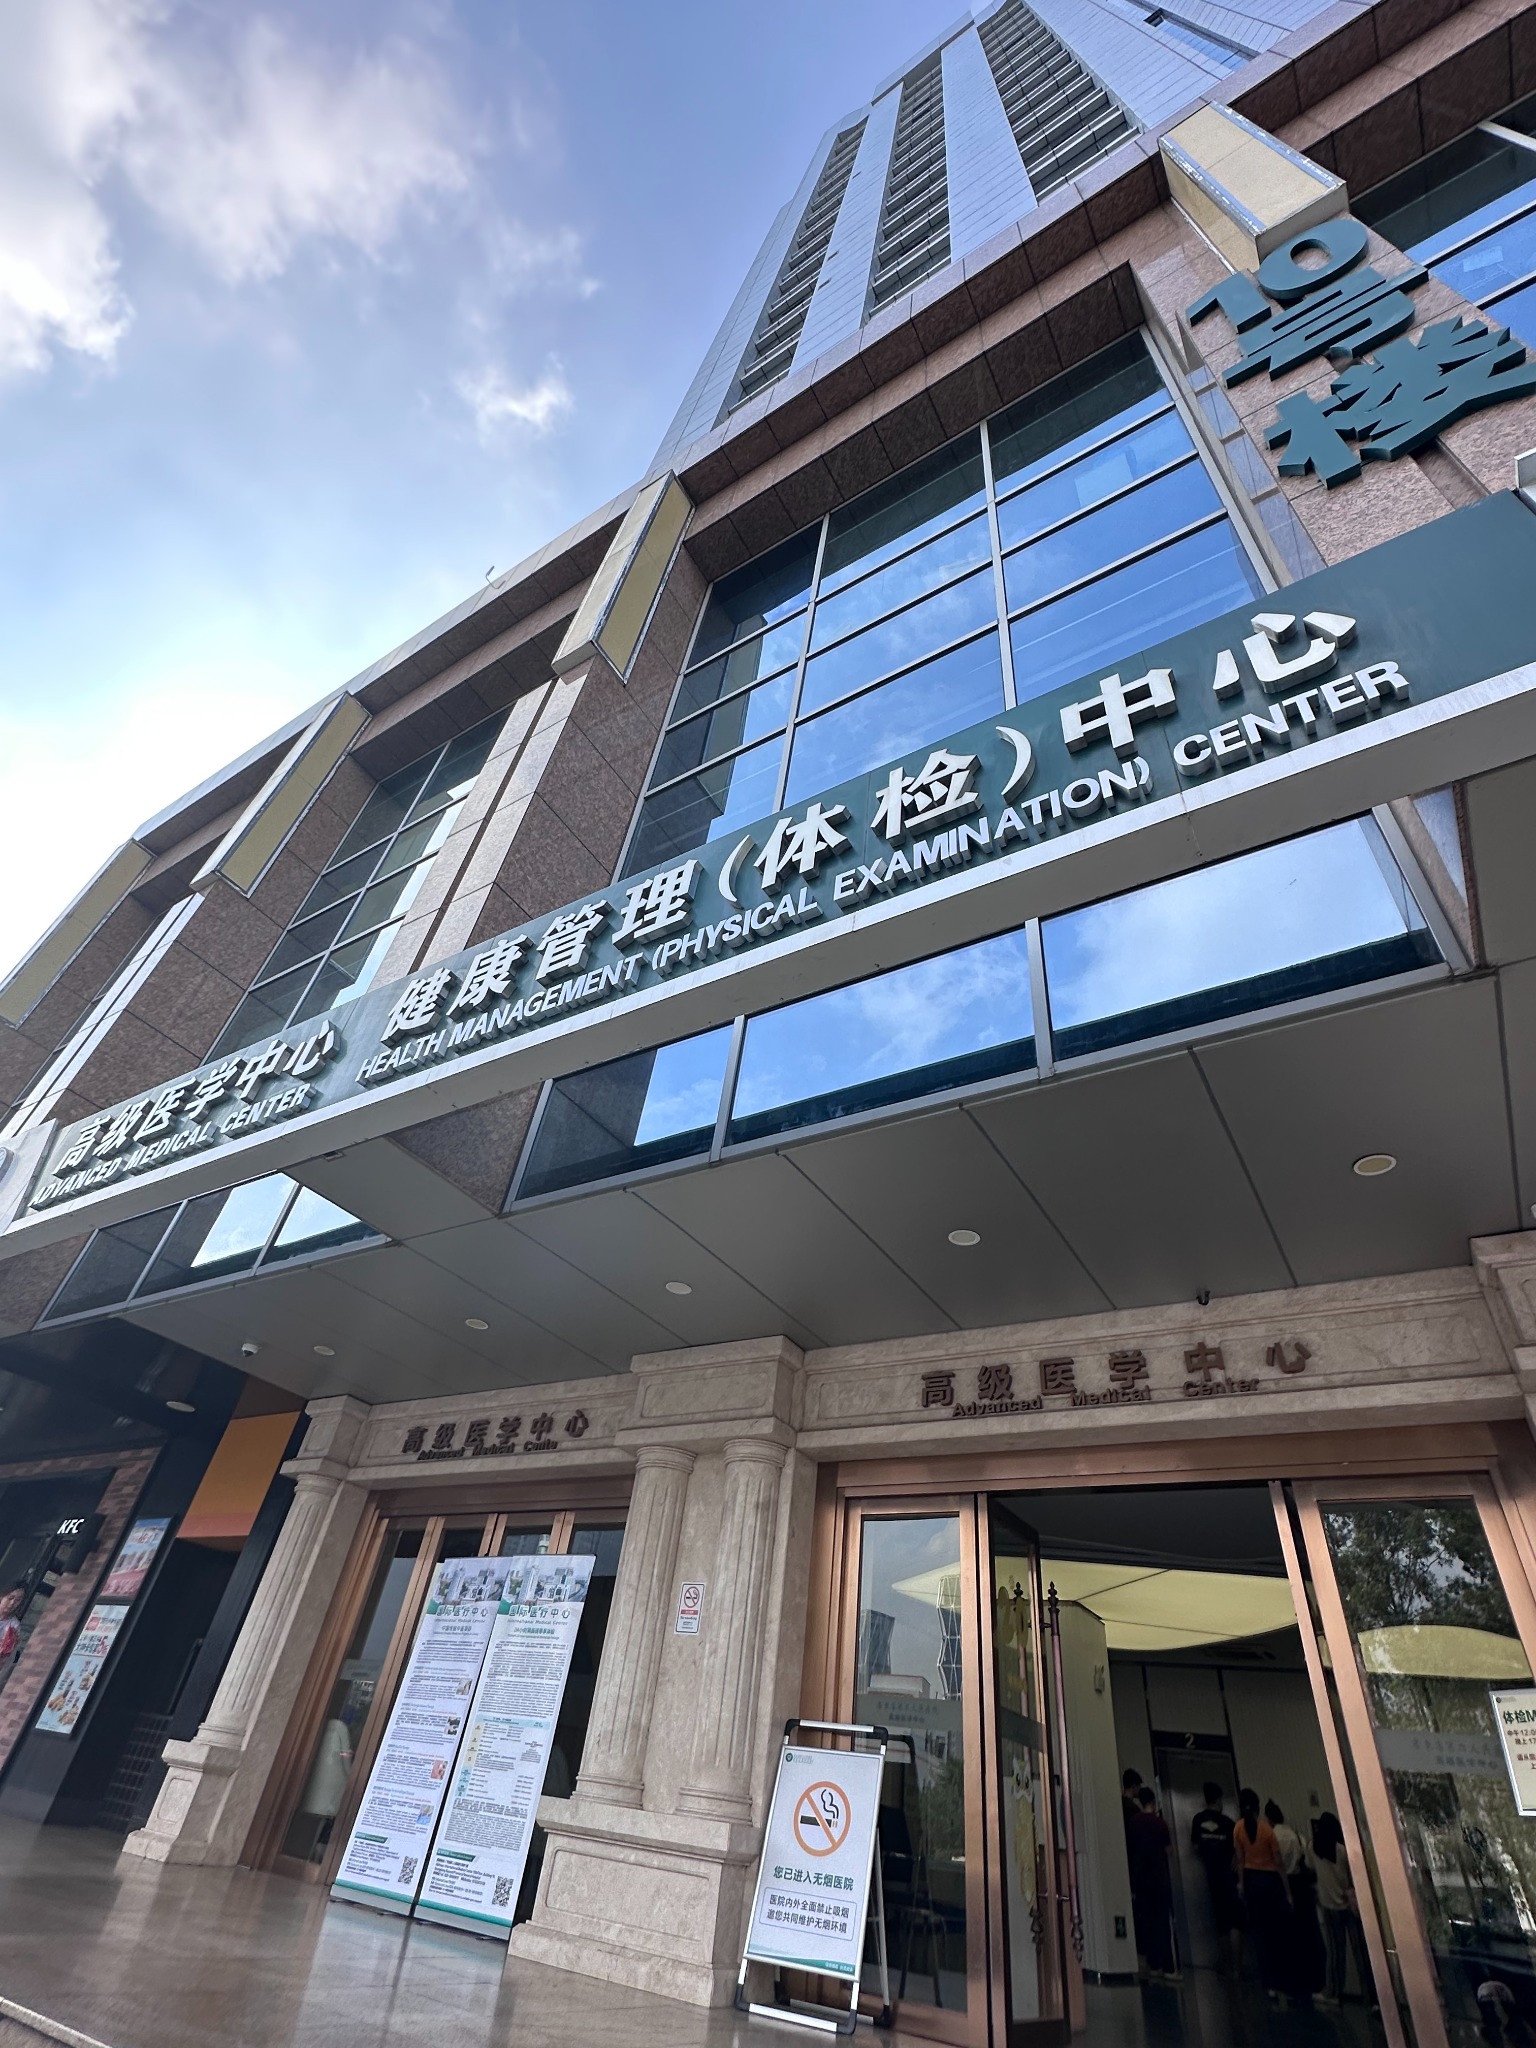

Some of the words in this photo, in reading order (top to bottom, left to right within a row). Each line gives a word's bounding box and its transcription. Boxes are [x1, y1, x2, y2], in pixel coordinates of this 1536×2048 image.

[355, 1028, 447, 1084] HEALTH
[447, 951, 645, 1050] MANAGEMENT
[651, 887, 820, 972] (PHYSICAL
[833, 756, 1154, 904] EXAMINATION)
[1172, 660, 1411, 776] CENTER
[52, 1018, 345, 1178] 高级医学中心
[28, 1156, 120, 1208] ADVANCED
[123, 1121, 213, 1173] MEDICAL
[219, 1083, 312, 1135] CENTER
[921, 1340, 1313, 1409] 高级医学中心
[953, 1395, 1044, 1418] Advanced
[1071, 1384, 1152, 1408] Medical
[1182, 1376, 1262, 1398] Center
[57, 1518, 85, 1534] KFC
[773, 1865, 854, 1891] 您已进入无烟医院
[769, 1894, 850, 1918] 医院内外全面禁止吸烟
